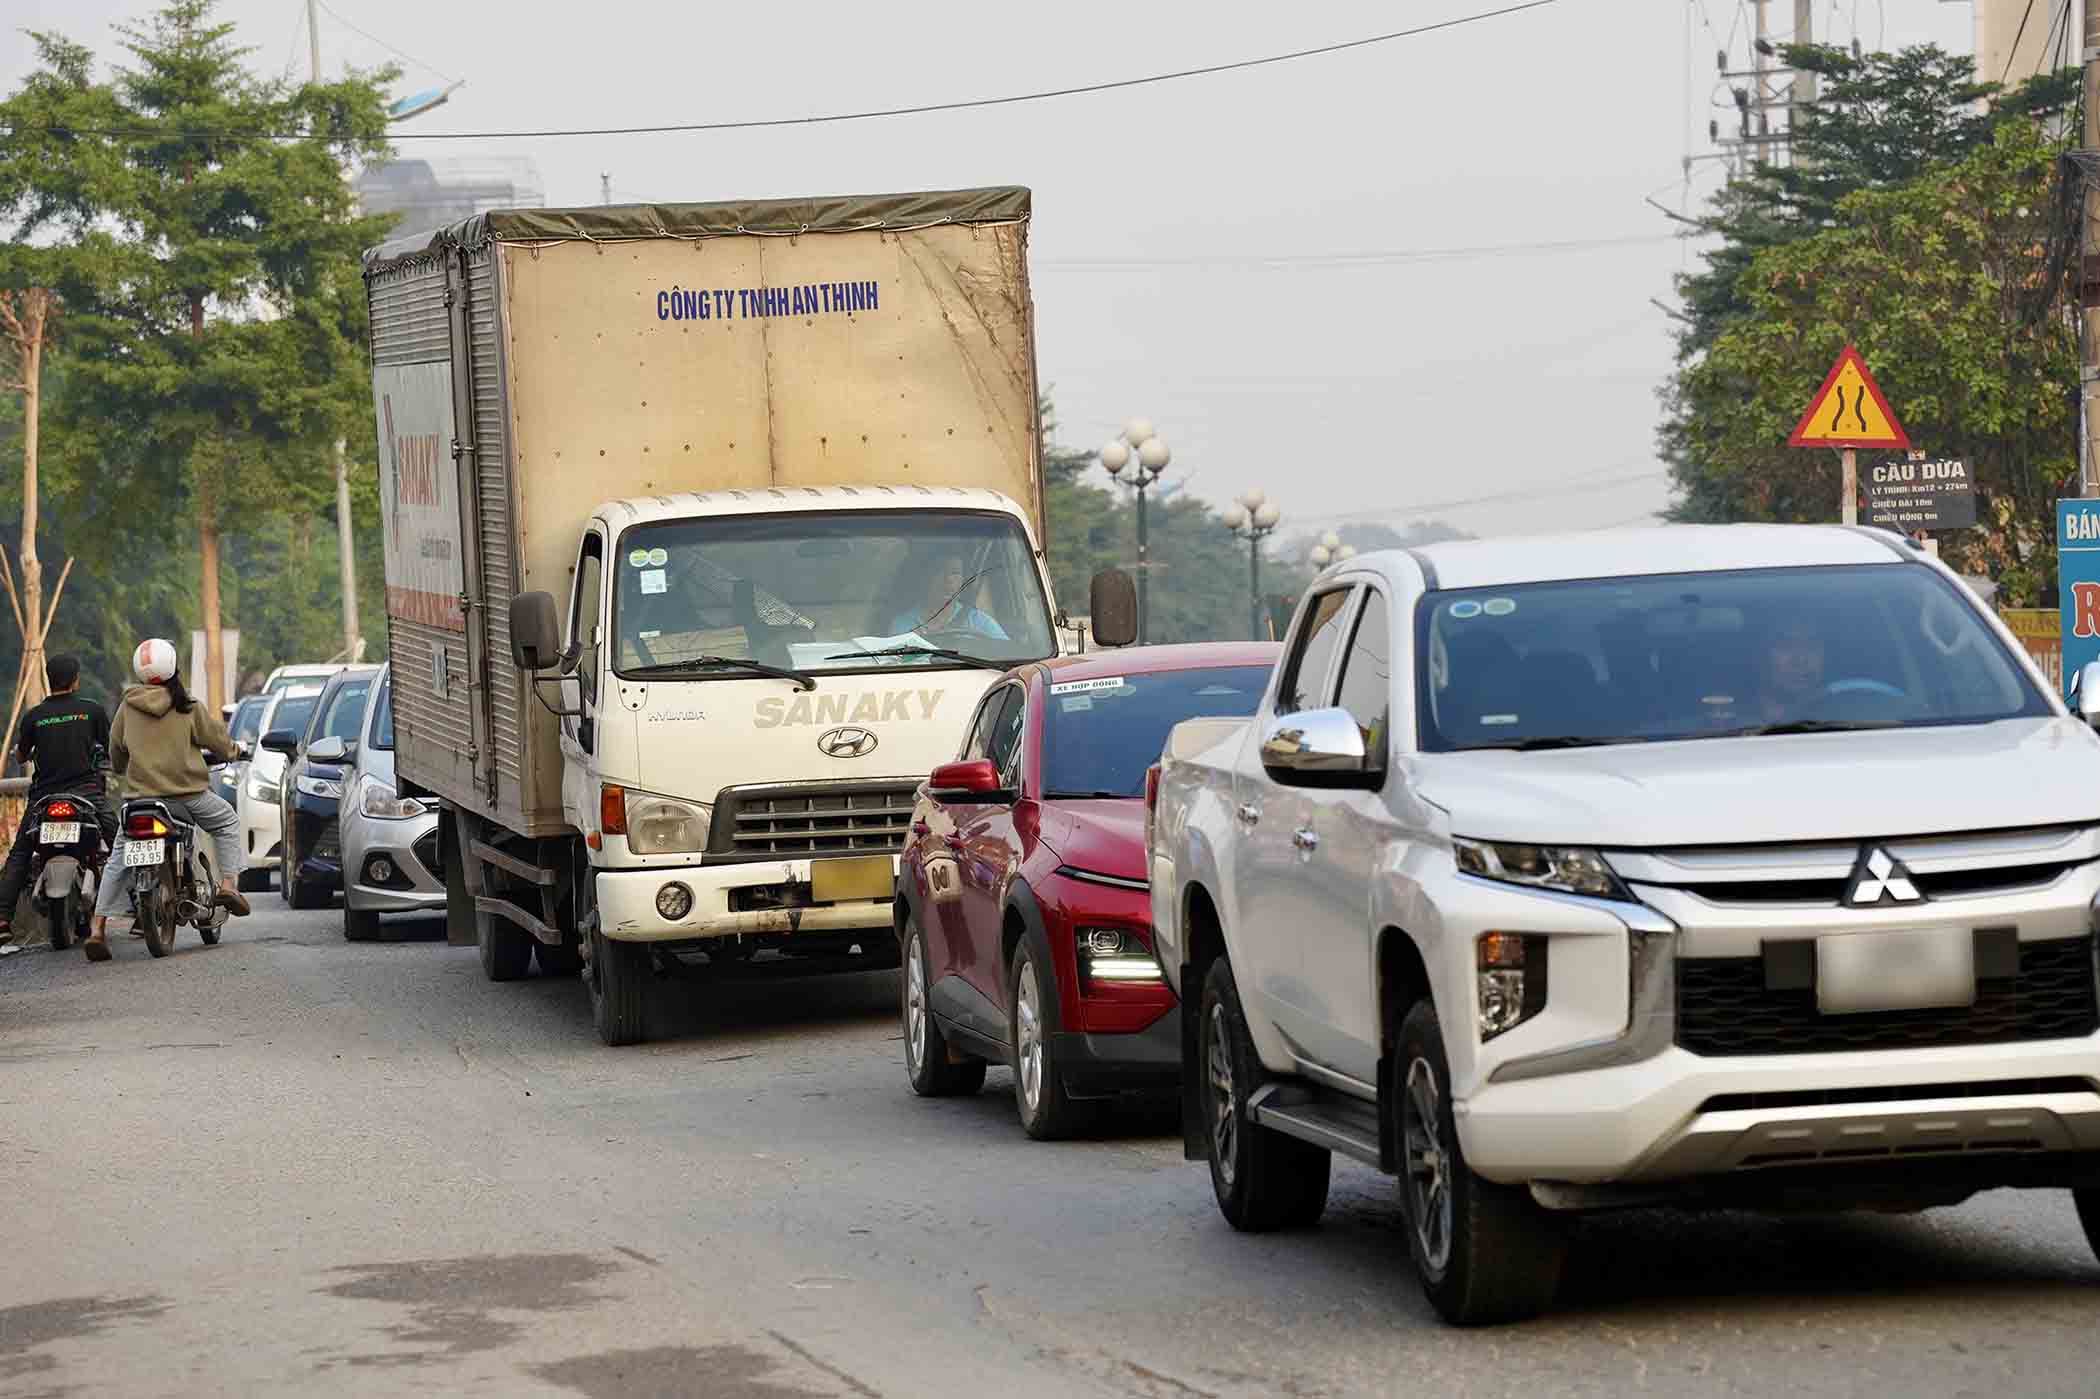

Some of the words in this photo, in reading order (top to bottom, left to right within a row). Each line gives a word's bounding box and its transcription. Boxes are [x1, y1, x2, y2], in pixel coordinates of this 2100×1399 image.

[656, 285, 711, 321] CÔNG
[713, 289, 735, 320] TY
[738, 286, 790, 319] TNHH
[792, 284, 819, 316] AN
[819, 280, 879, 317] THỊNH
[1872, 461, 1915, 482] CẦU
[1921, 458, 1966, 479] DỪA
[753, 687, 945, 729] SANAKY
